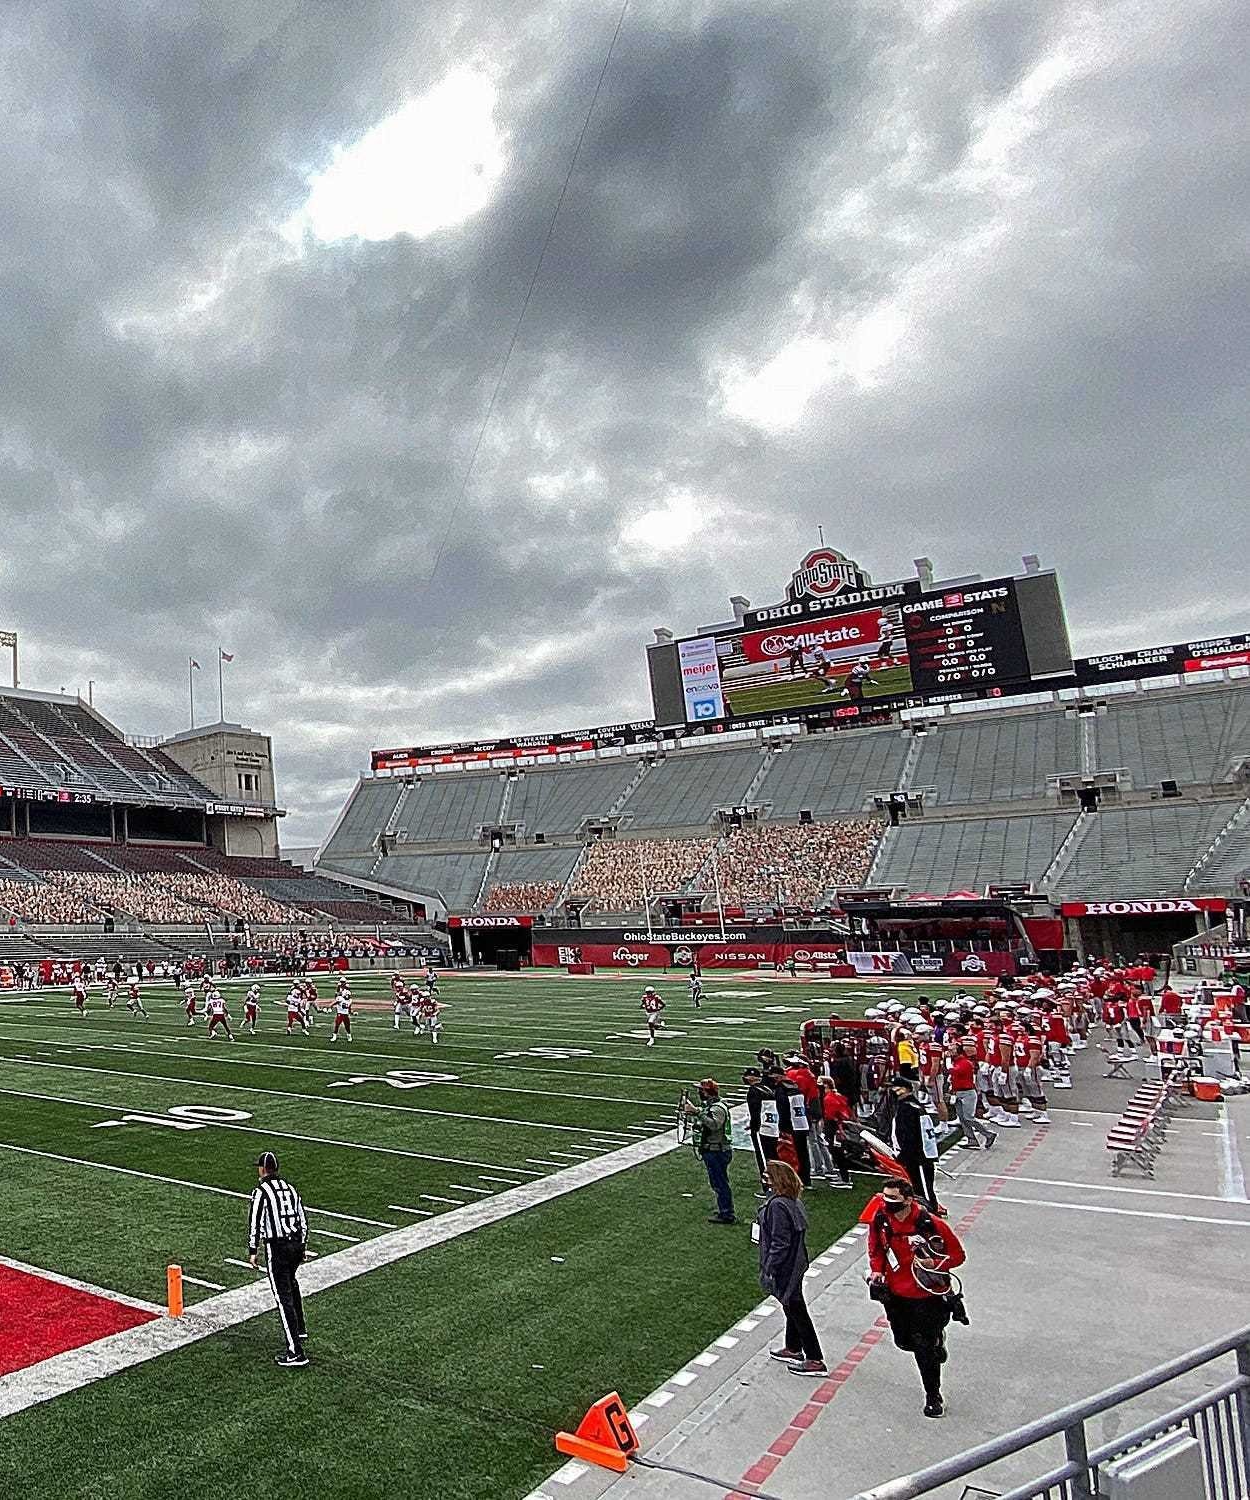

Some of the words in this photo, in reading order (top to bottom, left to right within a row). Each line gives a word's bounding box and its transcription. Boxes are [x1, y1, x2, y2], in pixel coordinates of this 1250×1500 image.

[795, 568, 819, 598] OHIO
[818, 562, 857, 588] STATE
[756, 603, 803, 622] OHIO
[808, 584, 906, 612] STADIUM
[902, 599, 944, 614] GAME
[963, 587, 1008, 603] STATS
[929, 607, 984, 621] COMPARISON
[1187, 638, 1232, 651] PHIPPS
[1088, 654, 1124, 665] BLOCH
[1136, 646, 1175, 658] CRANE
[1098, 655, 1168, 671] SCHUMAKER
[683, 663, 717, 677] meijer
[630, 720, 655, 730] WELLS
[74, 794, 92, 804] 2:35
[1084, 900, 1201, 915] HONDA
[460, 917, 521, 927] HONDA
[623, 932, 746, 942] OhioStateBuckeyes.com
[557, 946, 575, 956] Elk
[613, 947, 650, 967] Kroger
[871, 954, 894, 972] N
[121, 1104, 255, 1131] 10
[276, 1190, 296, 1216] H
[604, 1401, 636, 1452] G
